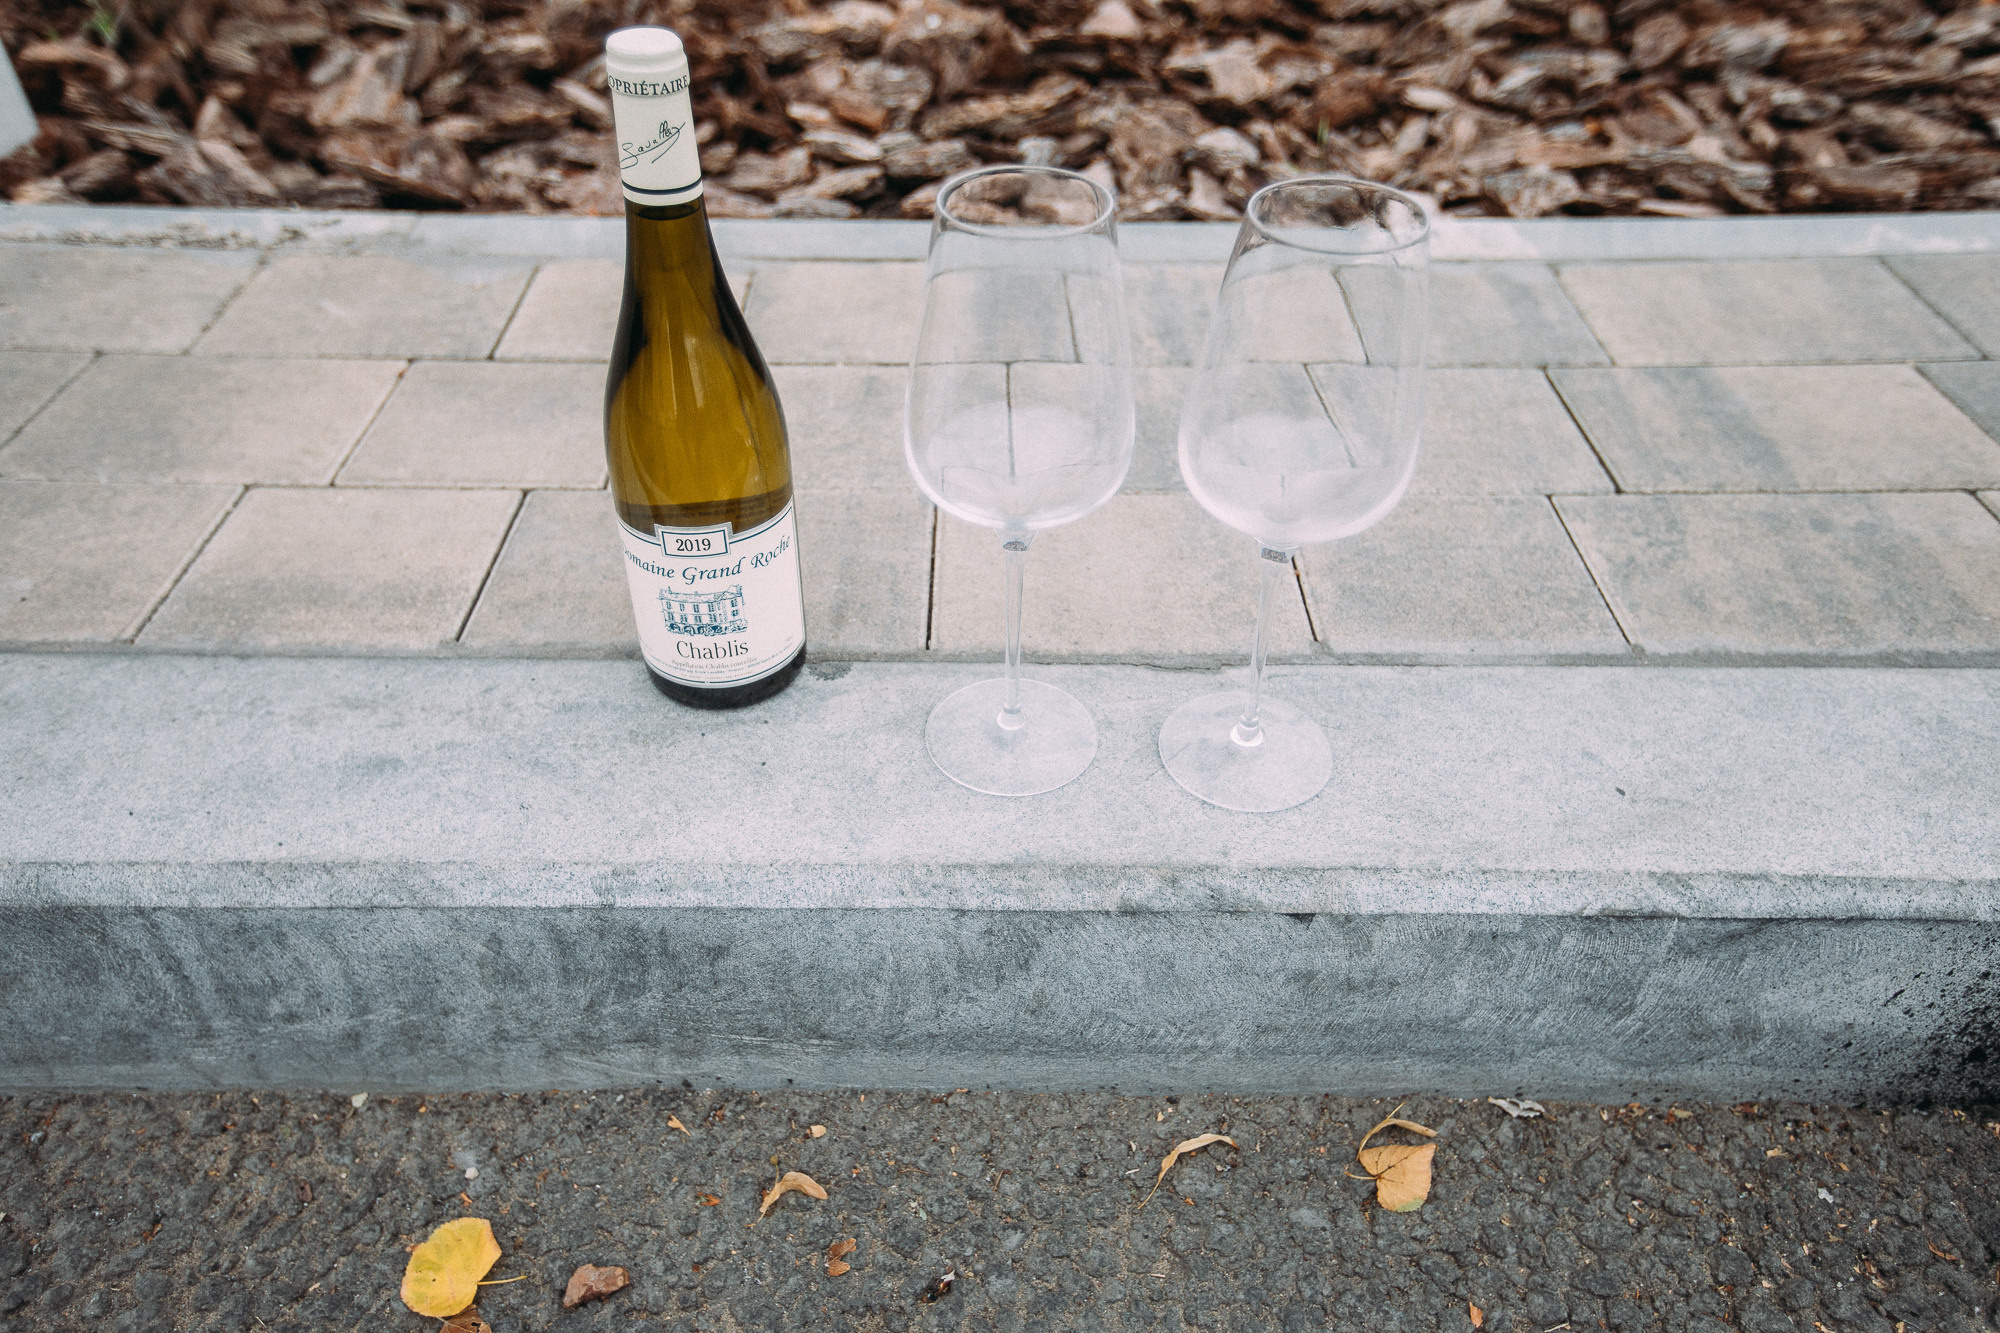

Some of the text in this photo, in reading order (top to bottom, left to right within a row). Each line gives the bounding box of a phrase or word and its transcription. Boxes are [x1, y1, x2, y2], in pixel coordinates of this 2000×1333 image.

[675, 538, 711, 552] 2019
[682, 556, 746, 585] Grand
[750, 535, 790, 569] Roche
[676, 639, 749, 660] Chablis
